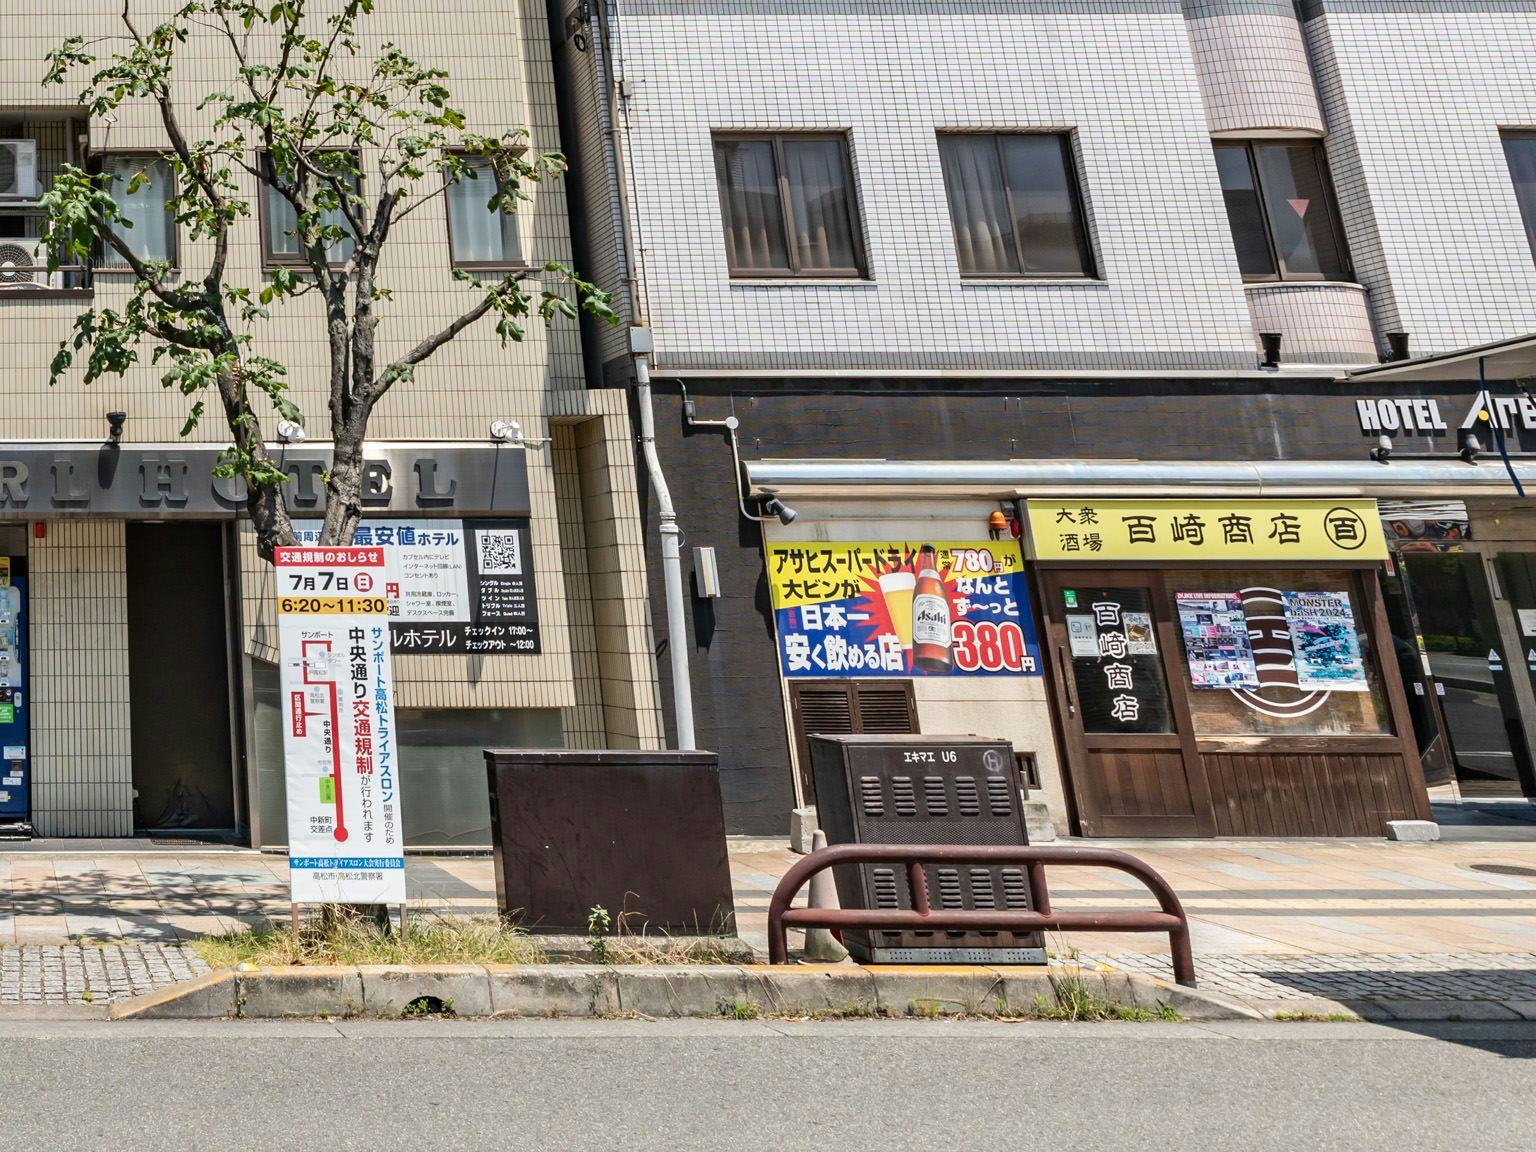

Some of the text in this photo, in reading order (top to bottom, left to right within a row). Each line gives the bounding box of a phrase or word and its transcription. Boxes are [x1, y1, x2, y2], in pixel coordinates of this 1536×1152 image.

[1356, 399, 1448, 430] HOTEL
[1056, 506, 1100, 525] 大衆
[353, 526, 460, 547] 最安値ホテル
[1121, 512, 1301, 547] 百崎商店
[1059, 533, 1104, 552] 酒場
[279, 551, 379, 563] 交通規制のおしらせ
[773, 548, 918, 575] アサヒスーパードライ
[783, 578, 862, 599] 大ビンが
[956, 576, 1010, 595] なんと
[1289, 598, 1342, 608] MONSTER
[800, 604, 870, 631] 日本一
[917, 609, 947, 625] Asahi
[301, 631, 334, 639] サンポート
[464, 626, 505, 636] チェックイン
[465, 640, 507, 649] チェックアウト
[784, 632, 904, 672] 安く飲める店
[1092, 601, 1140, 722] 百崎商店
[904, 751, 957, 763] エキマエ U6
